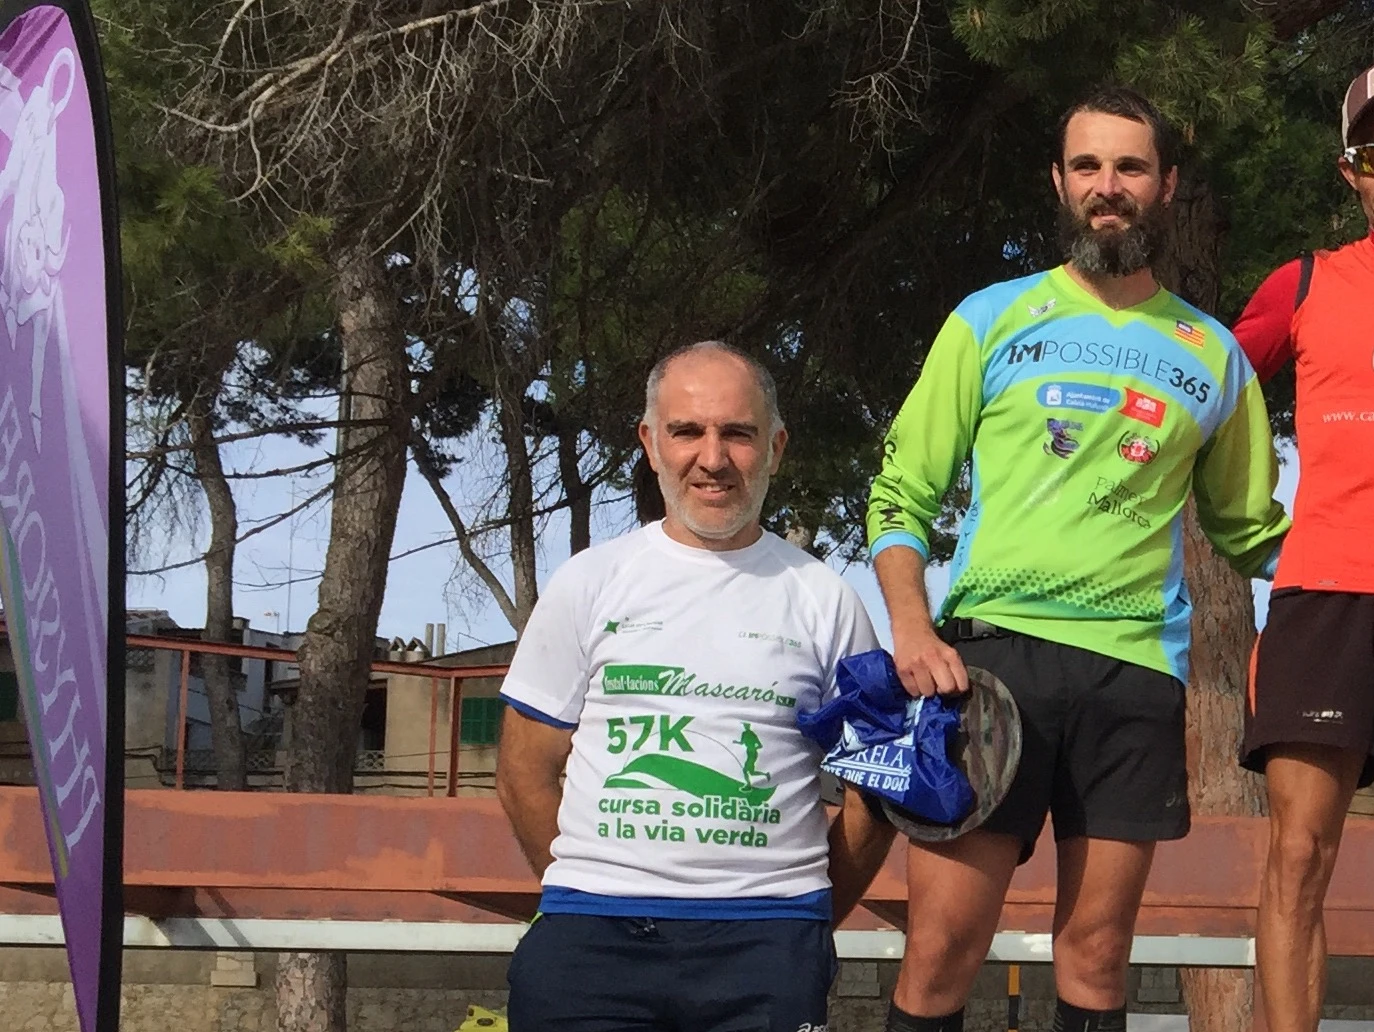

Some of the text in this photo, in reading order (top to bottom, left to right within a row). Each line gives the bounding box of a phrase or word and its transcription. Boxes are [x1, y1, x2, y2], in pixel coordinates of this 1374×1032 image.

[1007, 340, 1211, 403] IMPOSSIBLE365
[658, 669, 779, 702] Mascaró
[606, 714, 696, 755] 57K
[598, 795, 781, 825] cursa solidària
[597, 818, 769, 848] a la via verda
